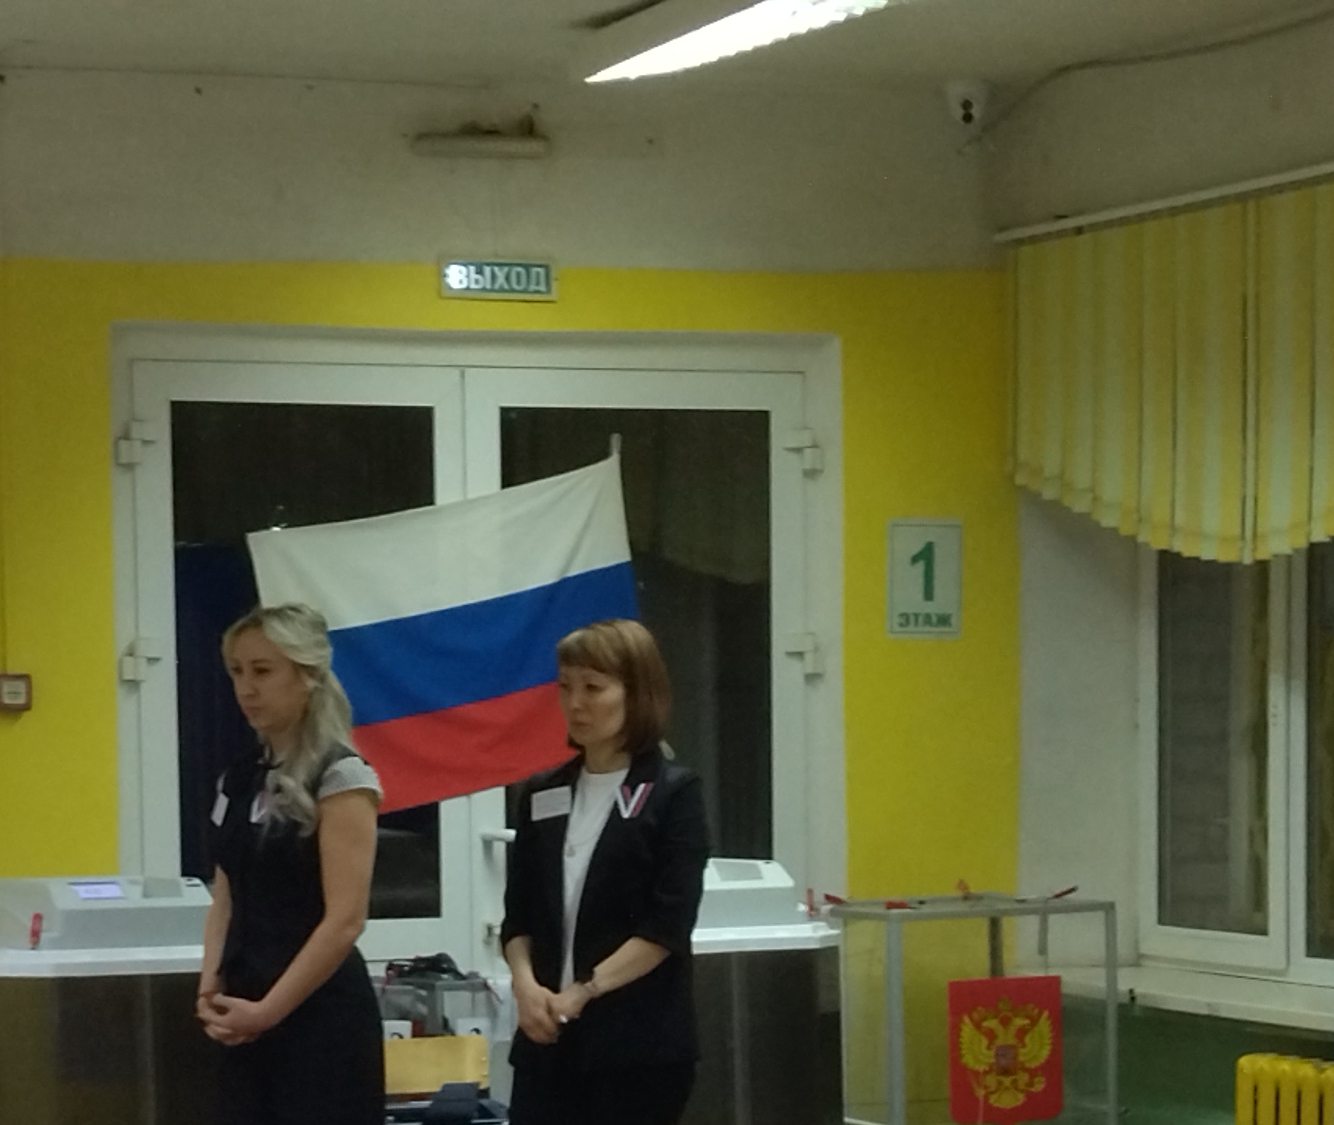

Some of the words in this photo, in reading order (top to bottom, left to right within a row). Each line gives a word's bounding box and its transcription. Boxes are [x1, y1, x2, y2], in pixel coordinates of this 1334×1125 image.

[446, 264, 548, 292] ВЫХОД
[910, 541, 935, 602] 1
[898, 612, 953, 628] ЭТАЖ
